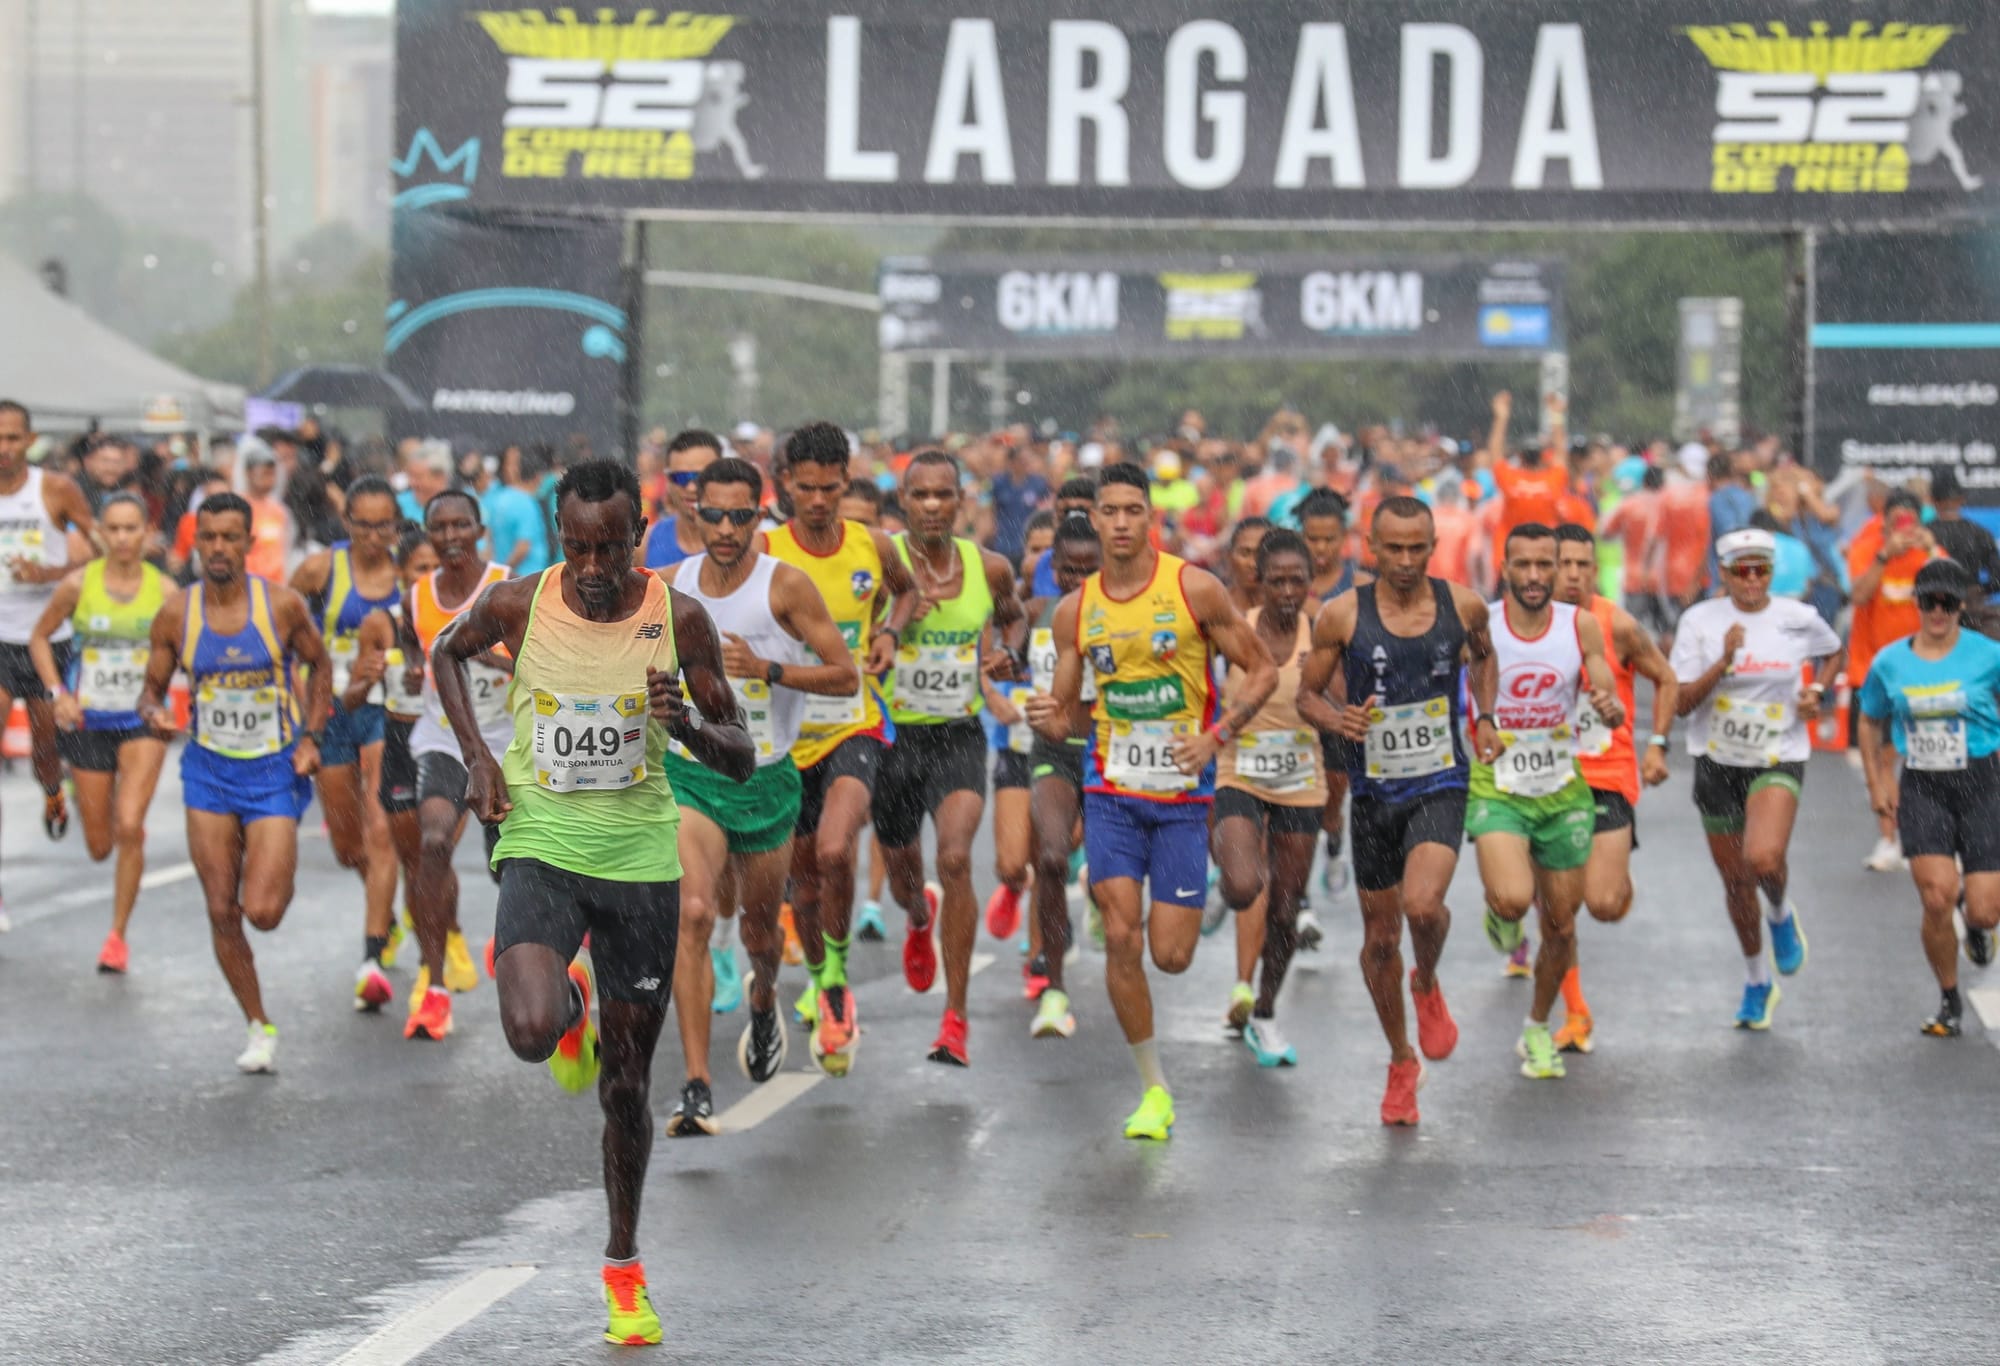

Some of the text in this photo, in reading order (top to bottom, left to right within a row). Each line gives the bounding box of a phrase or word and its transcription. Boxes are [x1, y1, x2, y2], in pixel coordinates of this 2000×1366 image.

[503, 57, 703, 129] 52
[825, 15, 1603, 189] LARGADA
[1713, 70, 1920, 142] 52
[503, 151, 694, 180] DE REIS
[1712, 167, 1909, 193] DE REIS
[998, 270, 1119, 331] 6KM
[1301, 270, 1423, 331] 6KM
[913, 670, 958, 691] 024
[1509, 673, 1556, 698] GP
[212, 710, 257, 731] 010
[1723, 719, 1765, 743] 047
[536, 722, 545, 753] ELITE
[554, 726, 620, 757] 049
[1382, 726, 1431, 751] 018
[552, 759, 624, 768] WILSON MUTUA
[1128, 744, 1174, 768] 015
[1255, 751, 1297, 774] 039
[1513, 749, 1555, 773] 004
